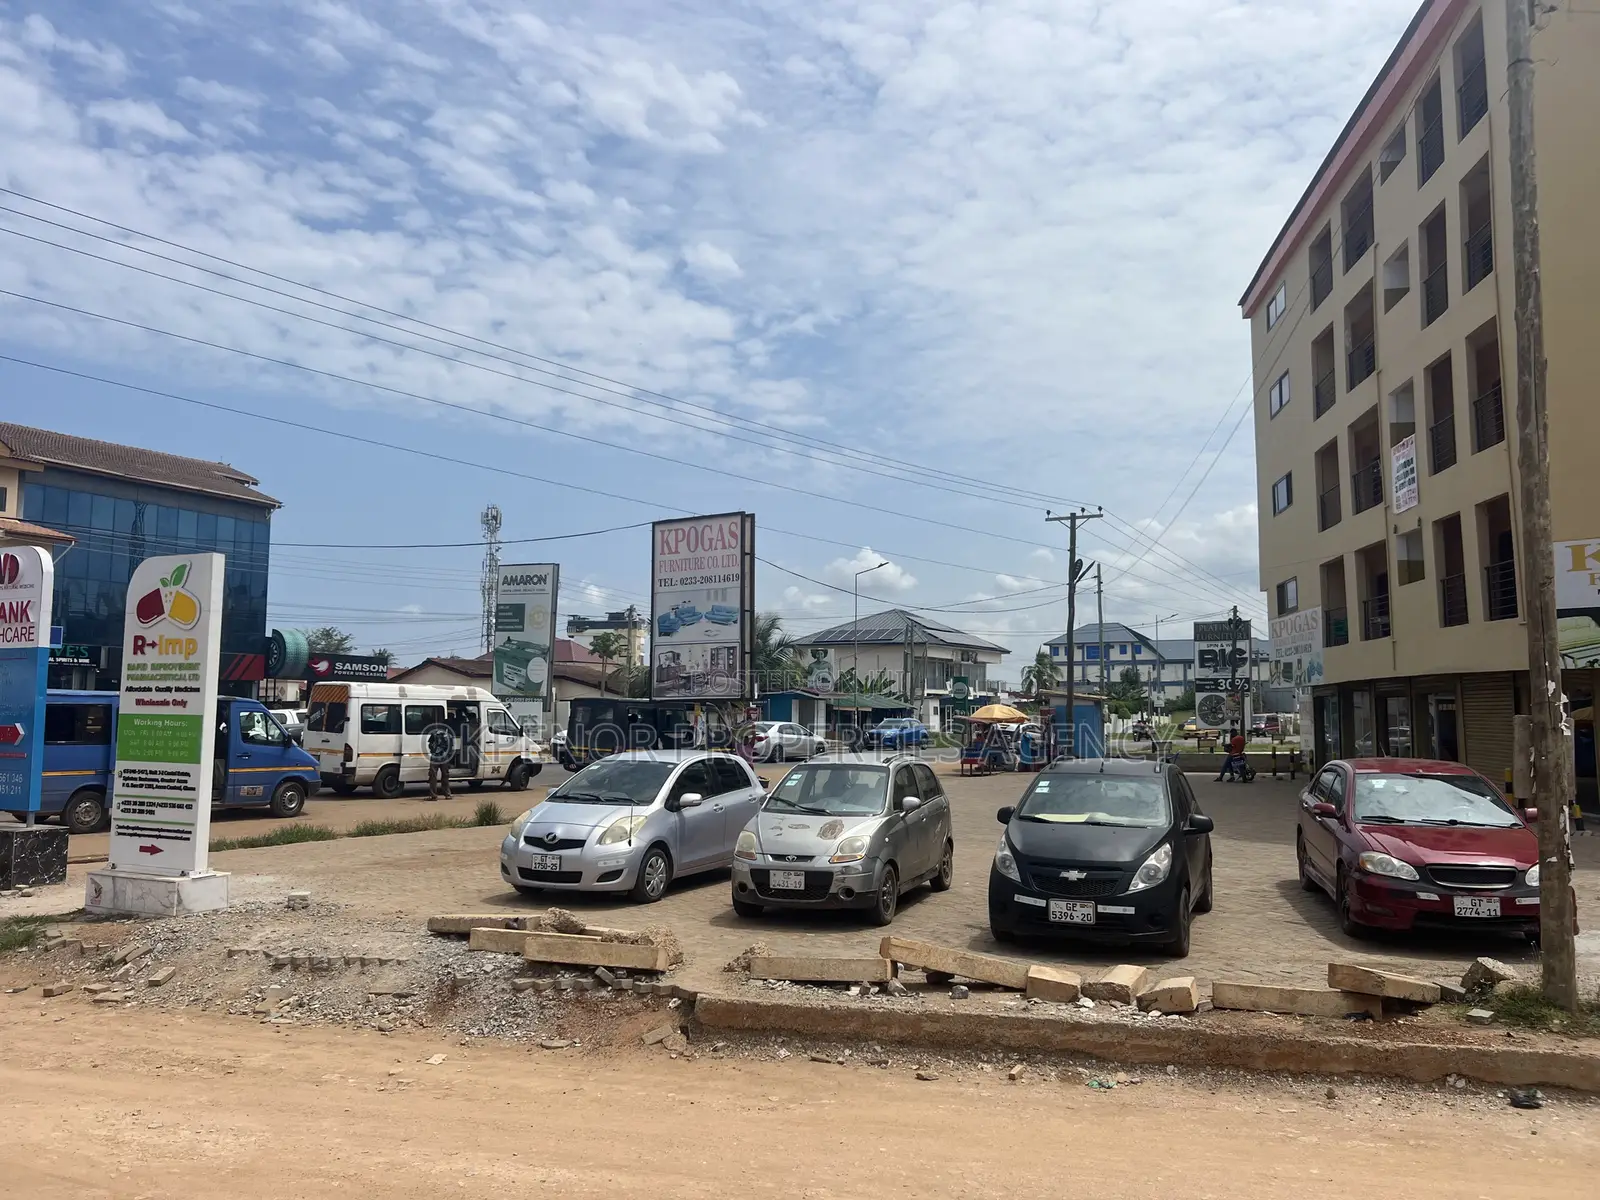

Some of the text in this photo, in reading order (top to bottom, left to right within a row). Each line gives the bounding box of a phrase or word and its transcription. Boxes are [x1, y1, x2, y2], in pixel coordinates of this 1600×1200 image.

[659, 521, 739, 556] KPOGAS
[659, 554, 740, 573] FURNITURE CO. LTD.
[502, 574, 547, 586] AMARON
[658, 578, 678, 588] TEL:
[1271, 610, 1318, 639] KPOGAS
[127, 662, 201, 671] RAPID IMPROVEMENT
[334, 662, 387, 673] SAMSON
[188, 674, 200, 682] LTD
[154, 686, 174, 694] Quality
[135, 698, 188, 708] Wholesale Only
[134, 718, 162, 728] Working
[534, 862, 558, 870] 1750-25
[1066, 902, 1078, 912] GE
[1471, 898, 1483, 907] GT
[1052, 910, 1092, 922] 5396-20
[1456, 906, 1498, 916] 2774-11
